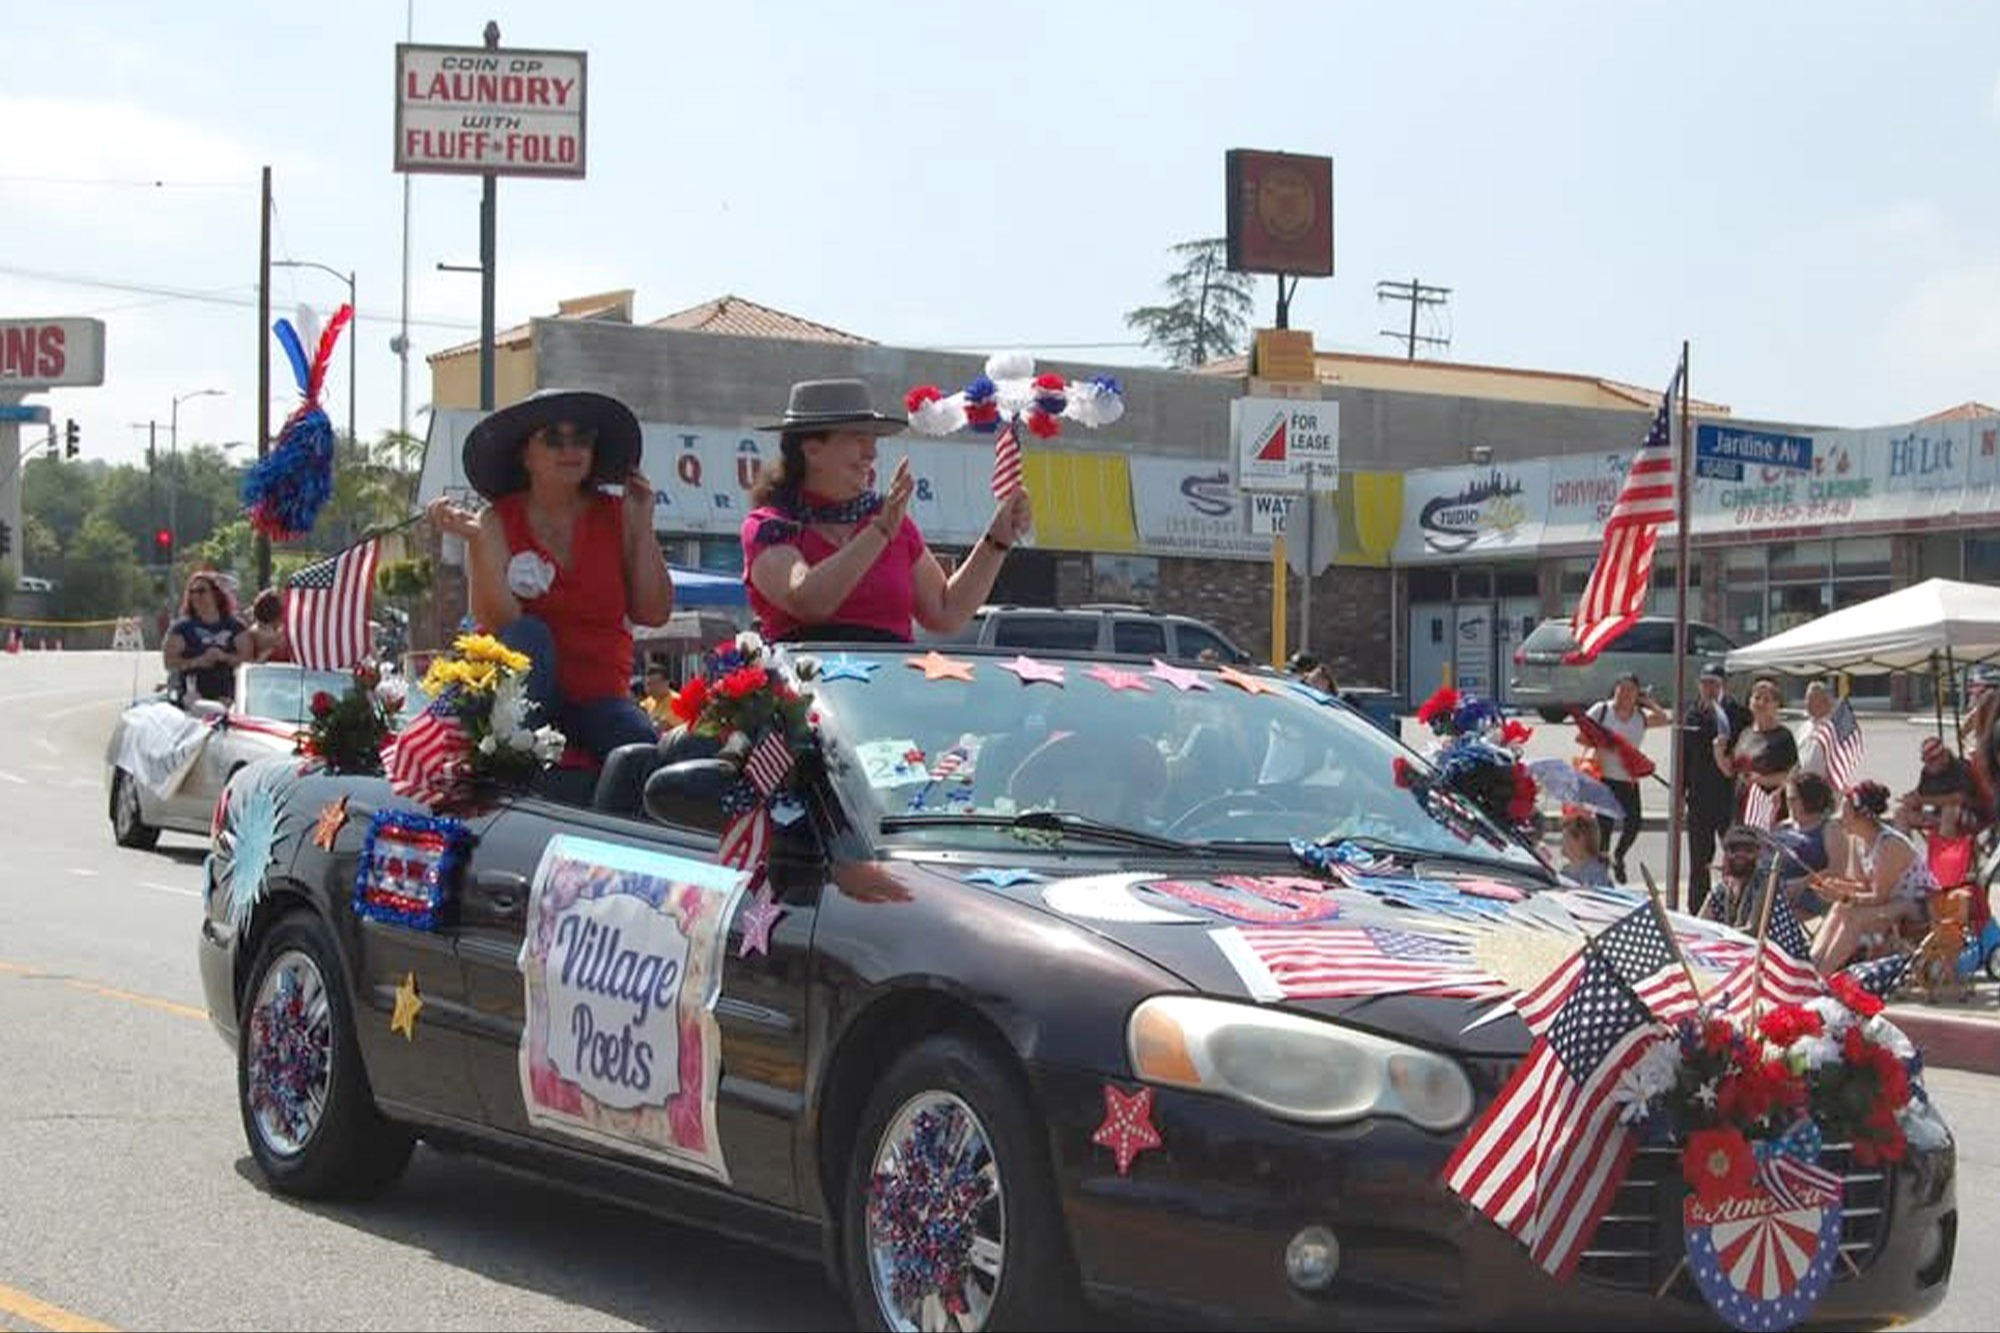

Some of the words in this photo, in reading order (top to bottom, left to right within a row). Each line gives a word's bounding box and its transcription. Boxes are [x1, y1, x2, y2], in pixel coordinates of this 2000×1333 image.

[442, 57, 499, 72] COIN
[509, 59, 544, 74] OP
[407, 71, 575, 106] LAUNDRY
[462, 116, 522, 130] WITH
[0, 324, 65, 378] NS
[1291, 413, 1318, 431] FOR
[1290, 434, 1332, 451] LEASE
[1711, 431, 1773, 459] Jardine
[558, 914, 678, 1026] Village
[572, 1002, 653, 1090] Poets
